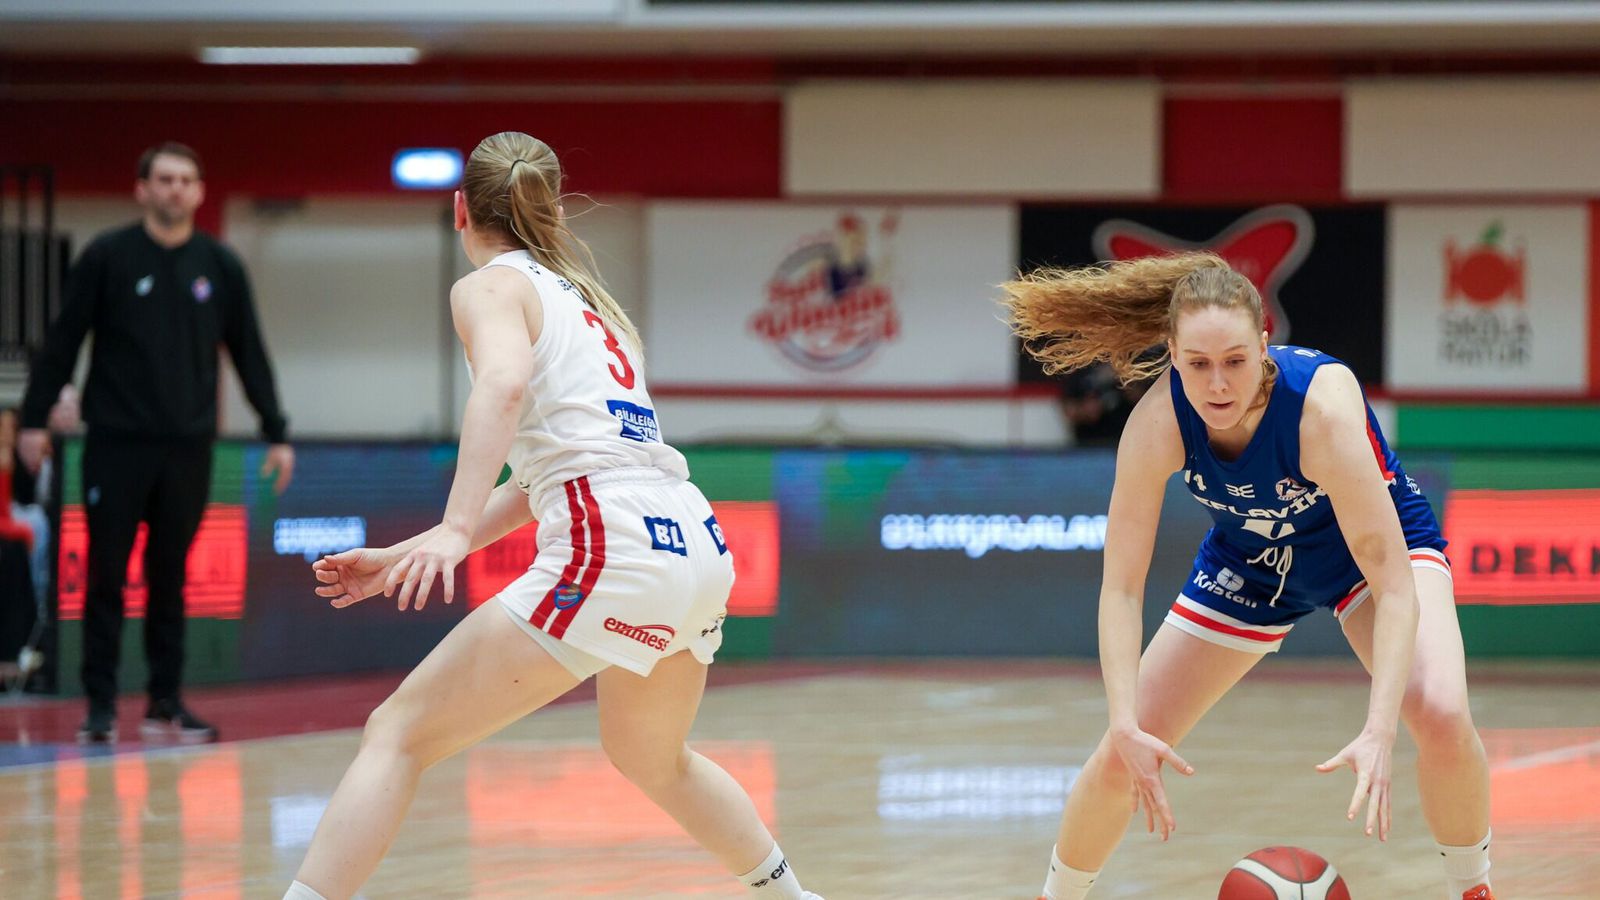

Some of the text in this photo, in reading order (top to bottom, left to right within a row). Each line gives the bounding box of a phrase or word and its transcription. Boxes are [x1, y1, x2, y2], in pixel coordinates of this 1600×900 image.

[582, 310, 635, 390] 3
[1191, 487, 1328, 519] EFLAVÍK
[653, 523, 686, 549] BL
